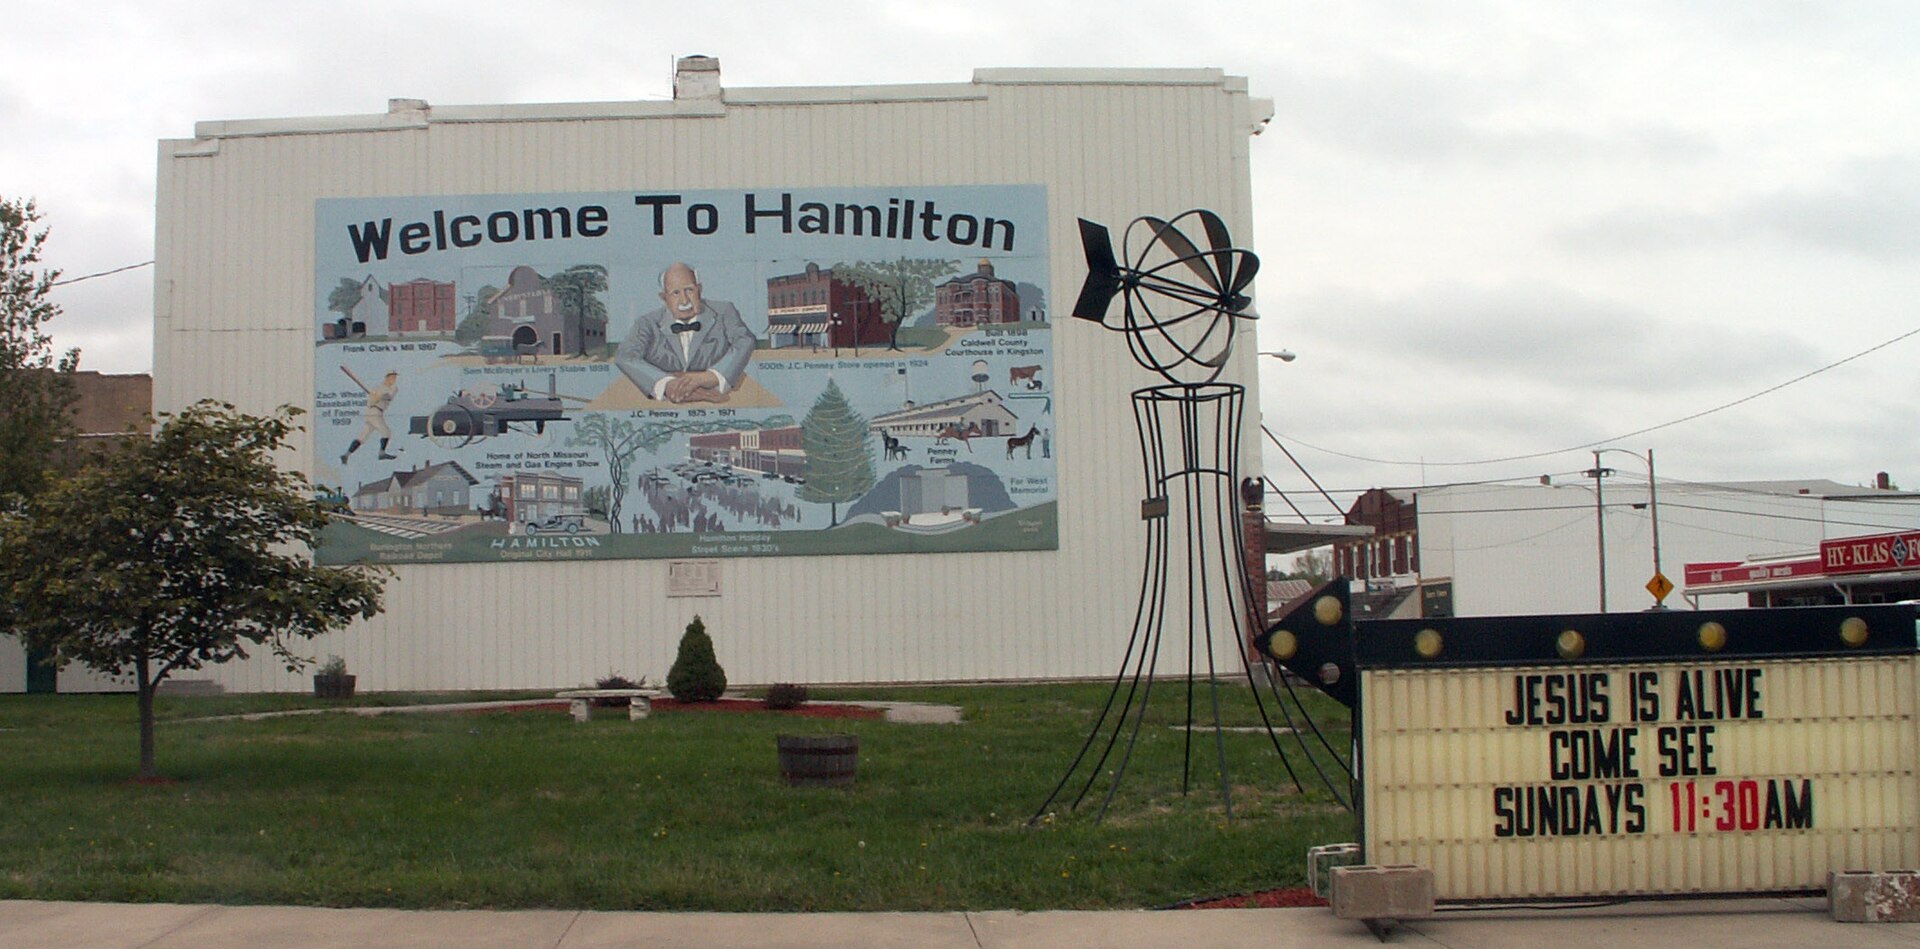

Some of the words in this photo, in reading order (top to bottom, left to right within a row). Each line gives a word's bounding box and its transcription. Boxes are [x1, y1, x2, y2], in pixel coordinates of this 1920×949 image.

[347, 204, 609, 264] Welcome
[634, 195, 719, 236] To
[745, 193, 1015, 252] Hamilton
[999, 339, 1028, 347] County
[369, 344, 397, 352] Clark's
[945, 348, 993, 356] Courthouse
[1007, 348, 1044, 356] Kingston
[560, 365, 586, 373] Stable
[759, 362, 784, 370] 500th
[804, 362, 834, 370] Penney
[863, 361, 895, 369] opened
[317, 391, 337, 399] Zach
[649, 410, 679, 418] Penney
[553, 451, 589, 459] Missouri
[927, 448, 958, 456] Penney
[544, 460, 573, 469] Engine
[490, 536, 600, 548] HAMILTON
[699, 534, 737, 542] Hamilton
[691, 545, 718, 553] Street
[721, 544, 749, 552] Scene
[1505, 673, 1610, 726] JESUS
[1629, 672, 1660, 722] IS
[1676, 669, 1764, 720] ALIVE
[1550, 729, 1639, 781] COME
[1658, 726, 1718, 777] SEE
[1494, 784, 1646, 837] SUNDAYS
